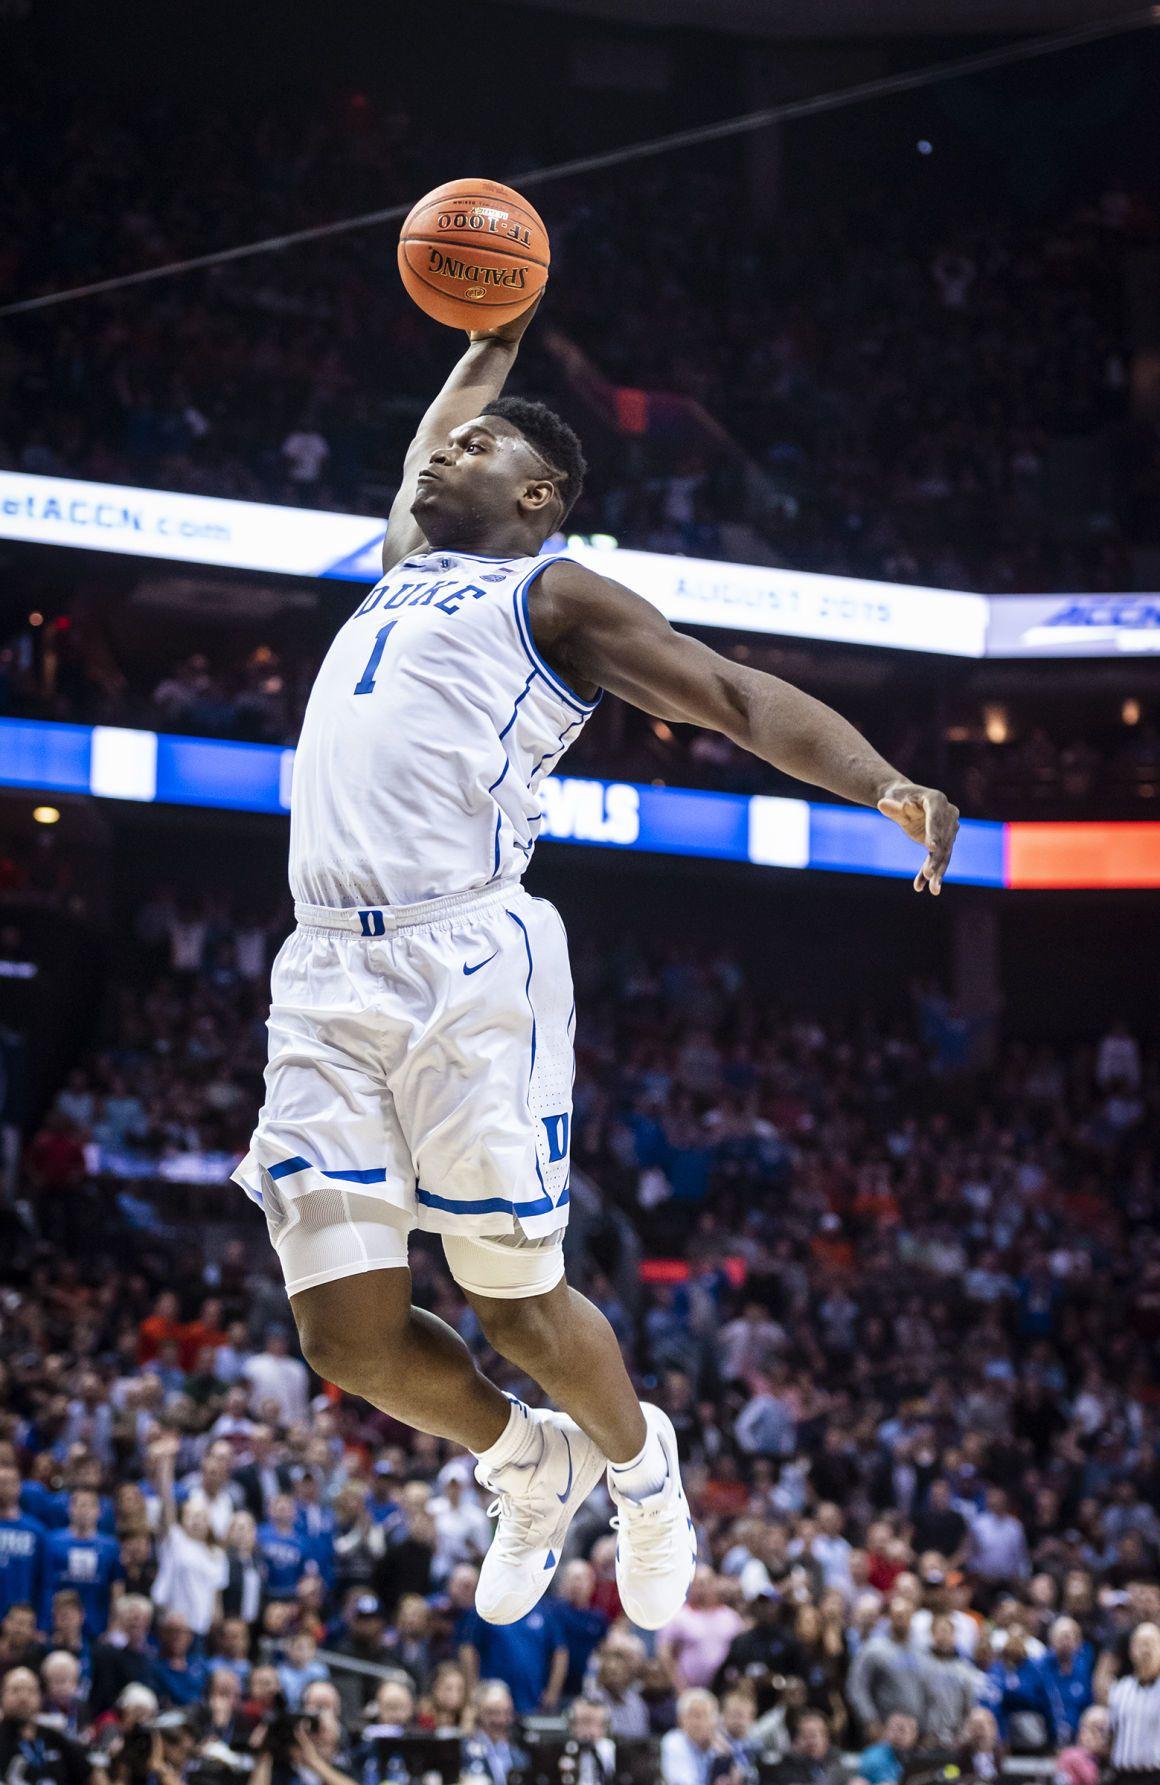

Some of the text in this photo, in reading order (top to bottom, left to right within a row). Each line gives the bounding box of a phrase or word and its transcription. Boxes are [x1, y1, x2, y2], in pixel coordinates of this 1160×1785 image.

[438, 213, 533, 246] TF-1000
[428, 248, 528, 289] SPALDING
[353, 580, 487, 619] DUKE
[353, 620, 398, 695] 1
[358, 910, 386, 937] D
[541, 1112, 569, 1163] D
